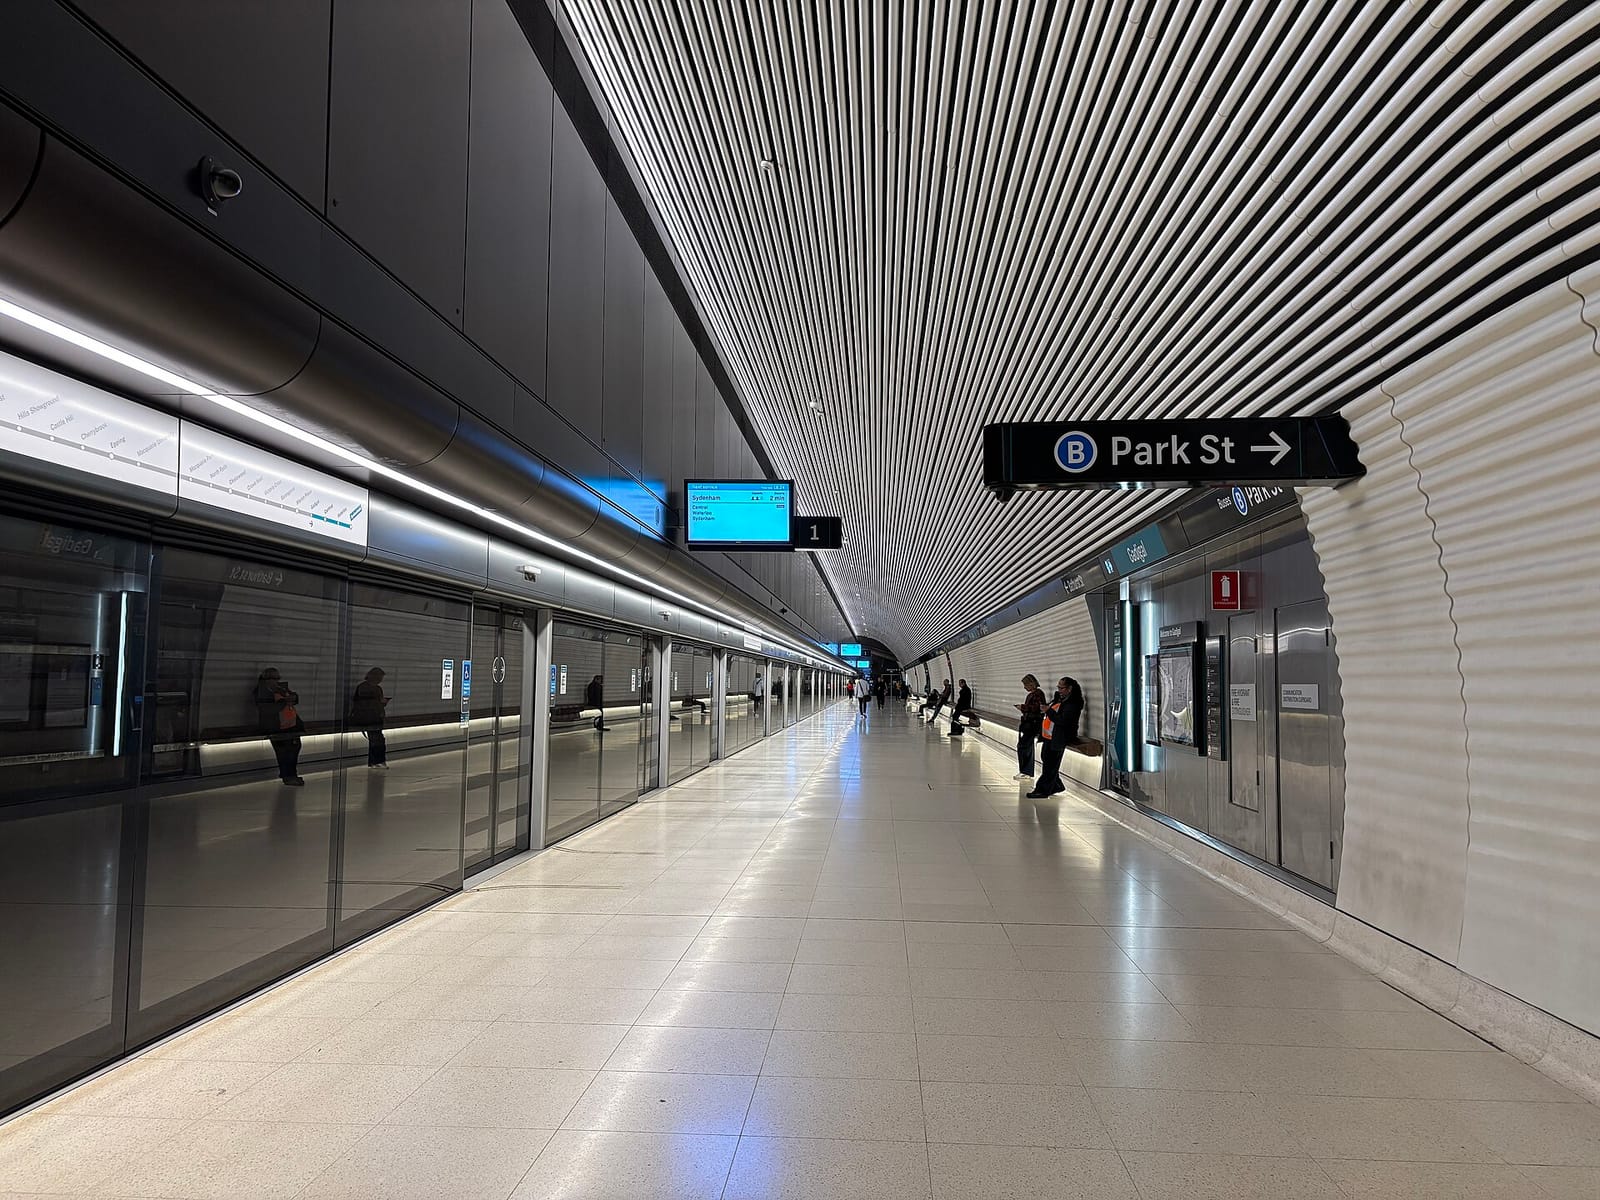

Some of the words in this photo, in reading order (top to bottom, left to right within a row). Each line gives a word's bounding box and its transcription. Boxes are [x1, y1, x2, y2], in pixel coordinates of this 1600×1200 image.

[1067, 441, 1085, 464] B
[1111, 434, 1191, 466] Park
[1200, 435, 1236, 465] St
[692, 494, 721, 502] Sydenham
[1216, 496, 1232, 510] Buses
[810, 525, 820, 540] 1
[1126, 539, 1148, 563] Gadigal
